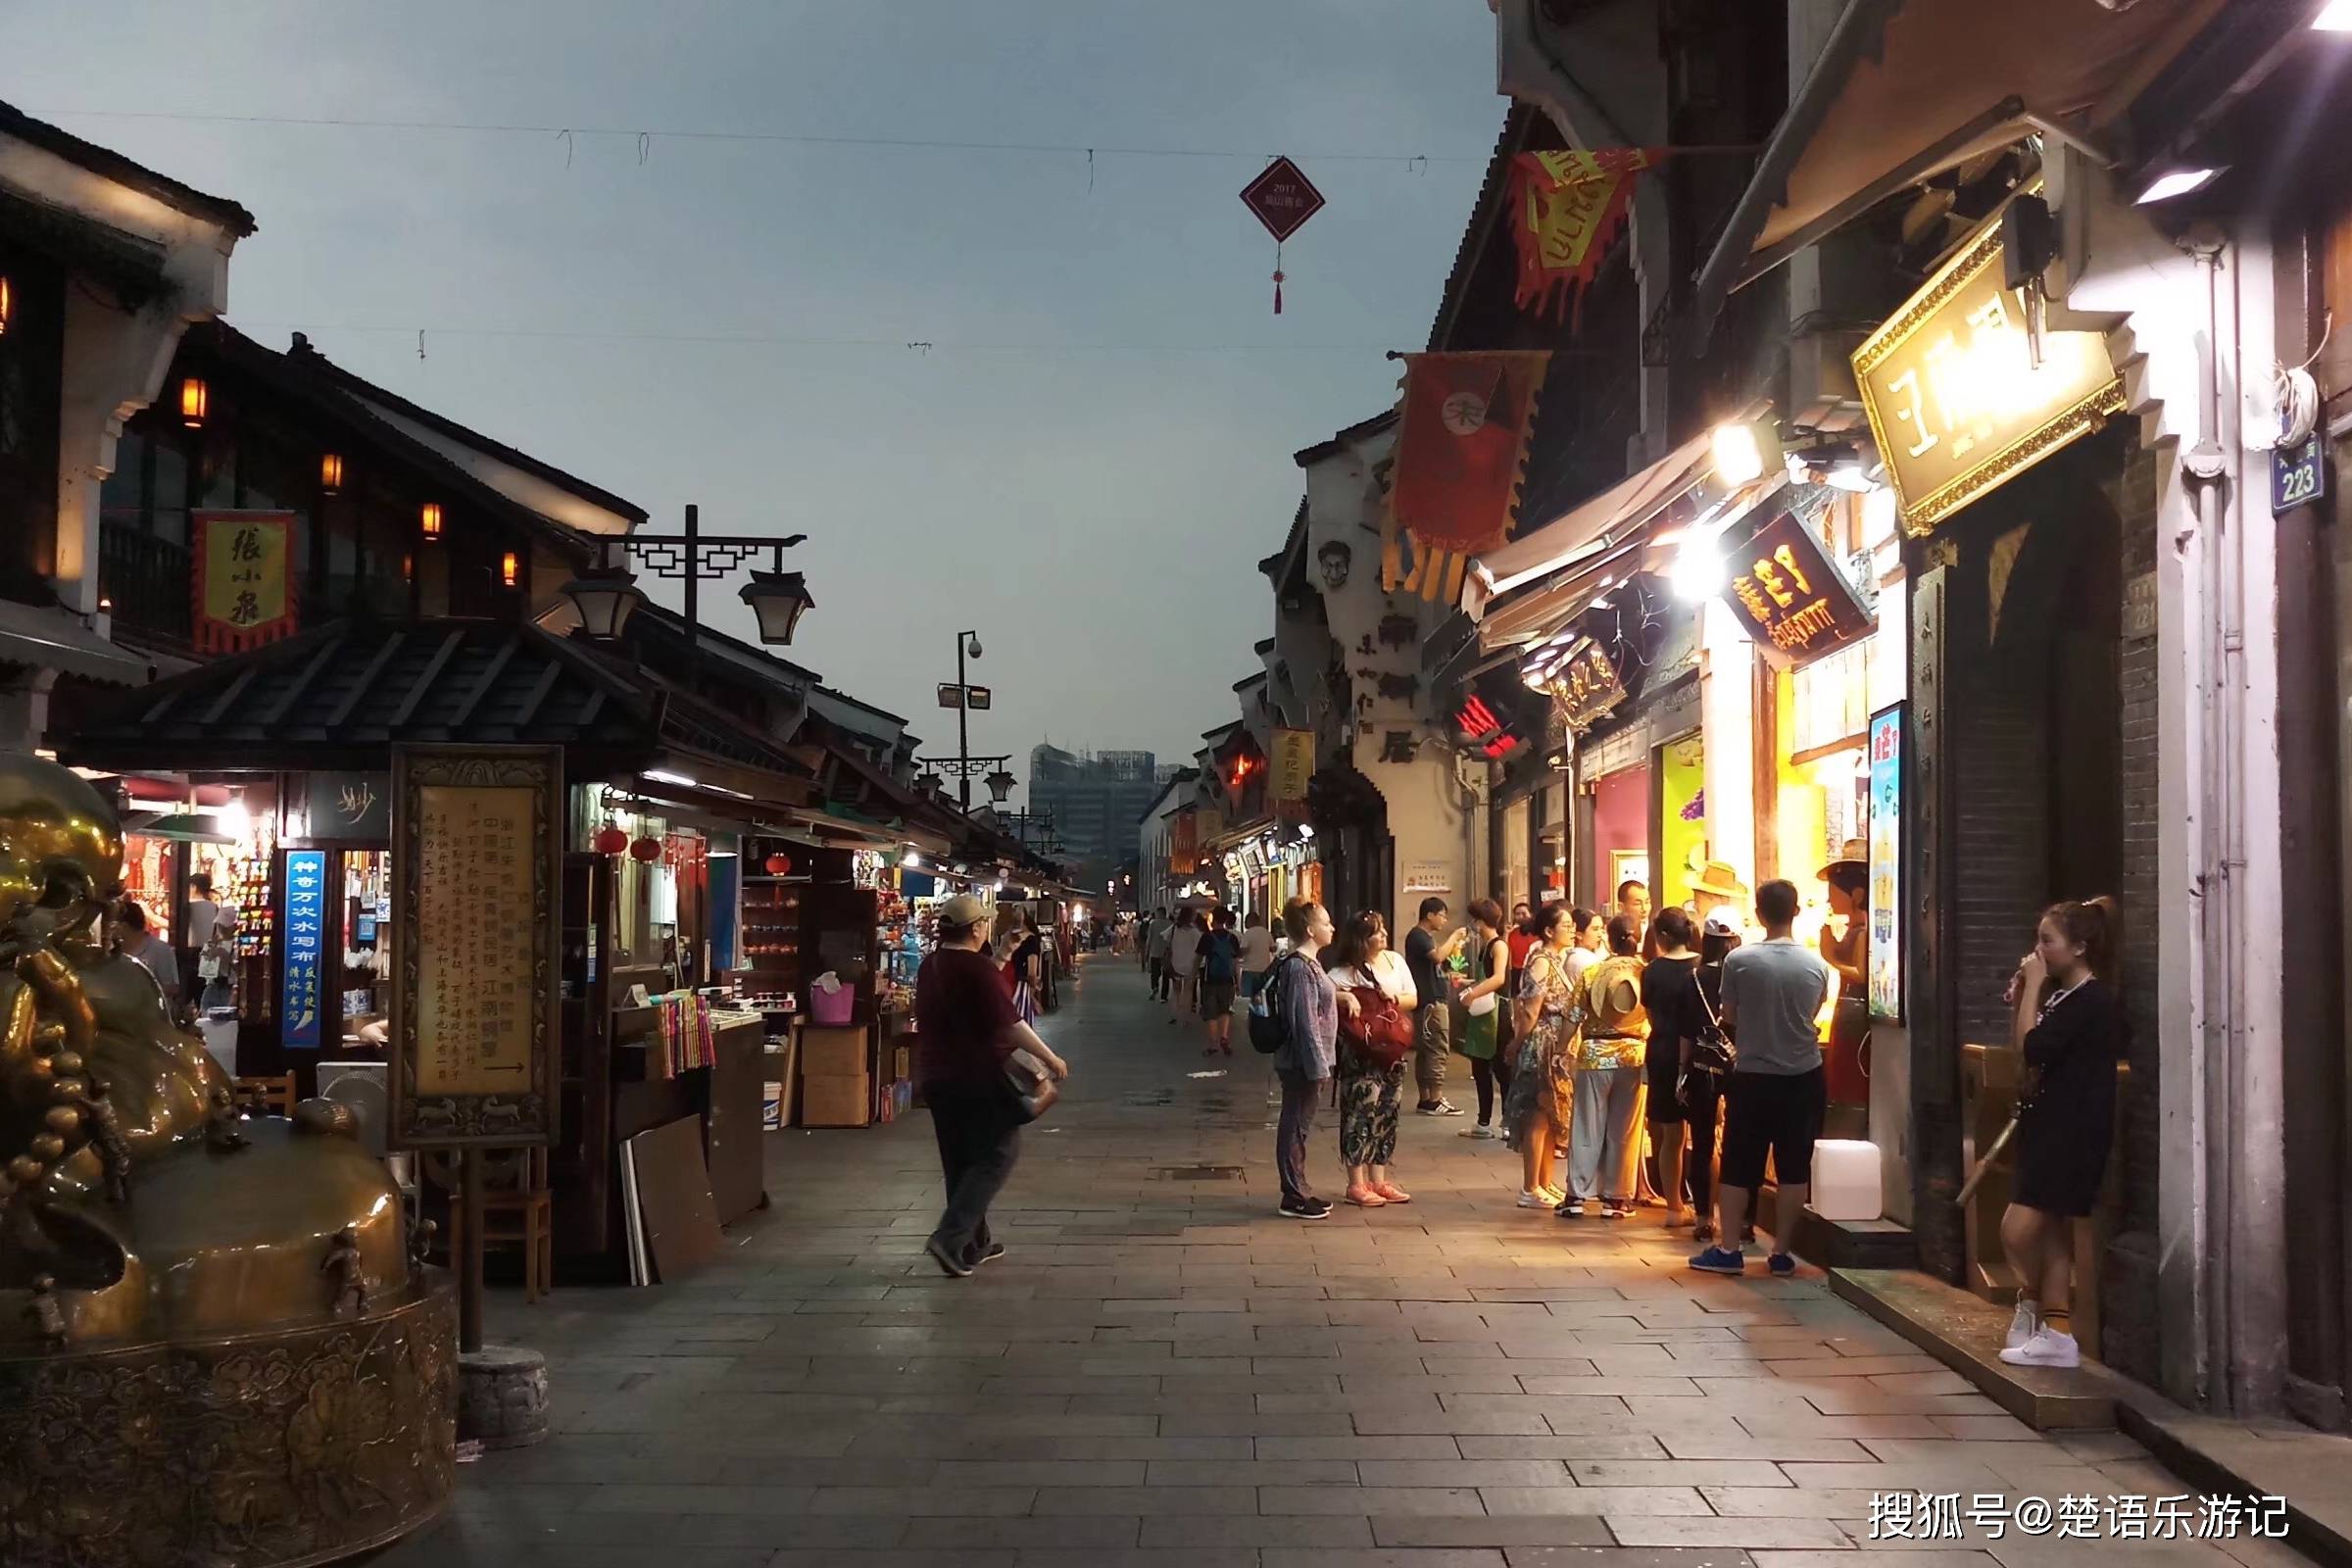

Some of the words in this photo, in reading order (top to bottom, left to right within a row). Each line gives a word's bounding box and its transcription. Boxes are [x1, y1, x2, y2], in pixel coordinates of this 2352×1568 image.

[1273, 183, 1297, 194] 2017
[2282, 464, 2315, 502] 223
[336, 781, 378, 825] 妙
[291, 859, 318, 963] 神奇万次水写布
